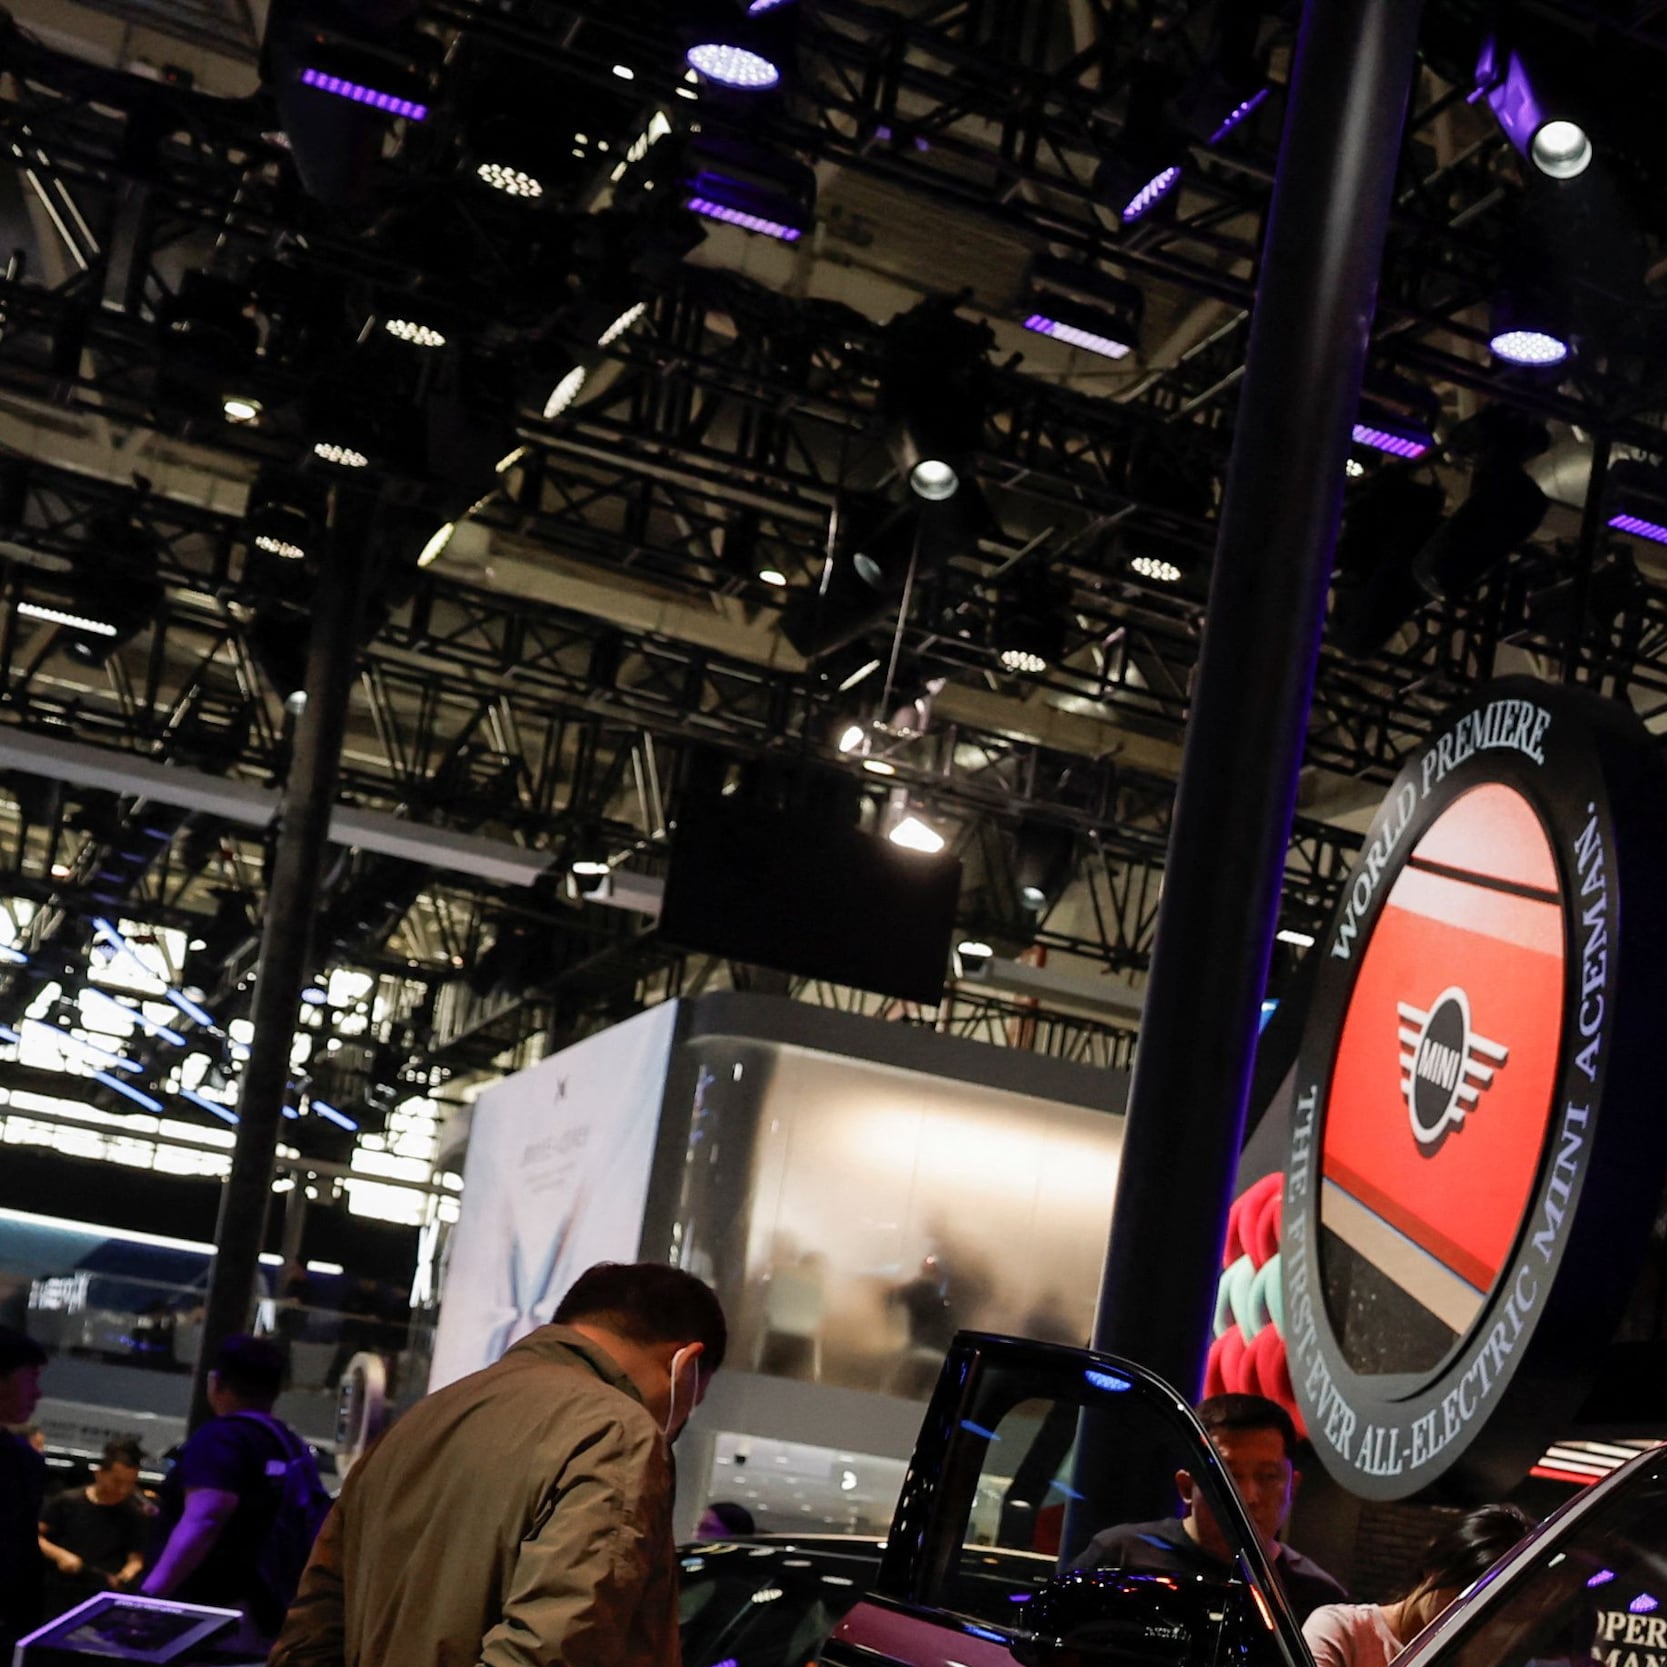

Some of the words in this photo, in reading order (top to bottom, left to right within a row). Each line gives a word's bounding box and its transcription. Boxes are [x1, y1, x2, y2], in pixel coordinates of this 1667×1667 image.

[1330, 781, 1416, 960] WORLD
[1420, 699, 1552, 799] PREMIERE.
[1573, 801, 1607, 1083] ACEMAN.
[1288, 1084, 1317, 1203] THE
[1417, 1037, 1461, 1092] MINI
[1531, 1101, 1591, 1263] MINI
[1288, 1208, 1357, 1461] FIRST-EVER
[1355, 1266, 1537, 1477] ALL-ELECTRIC
